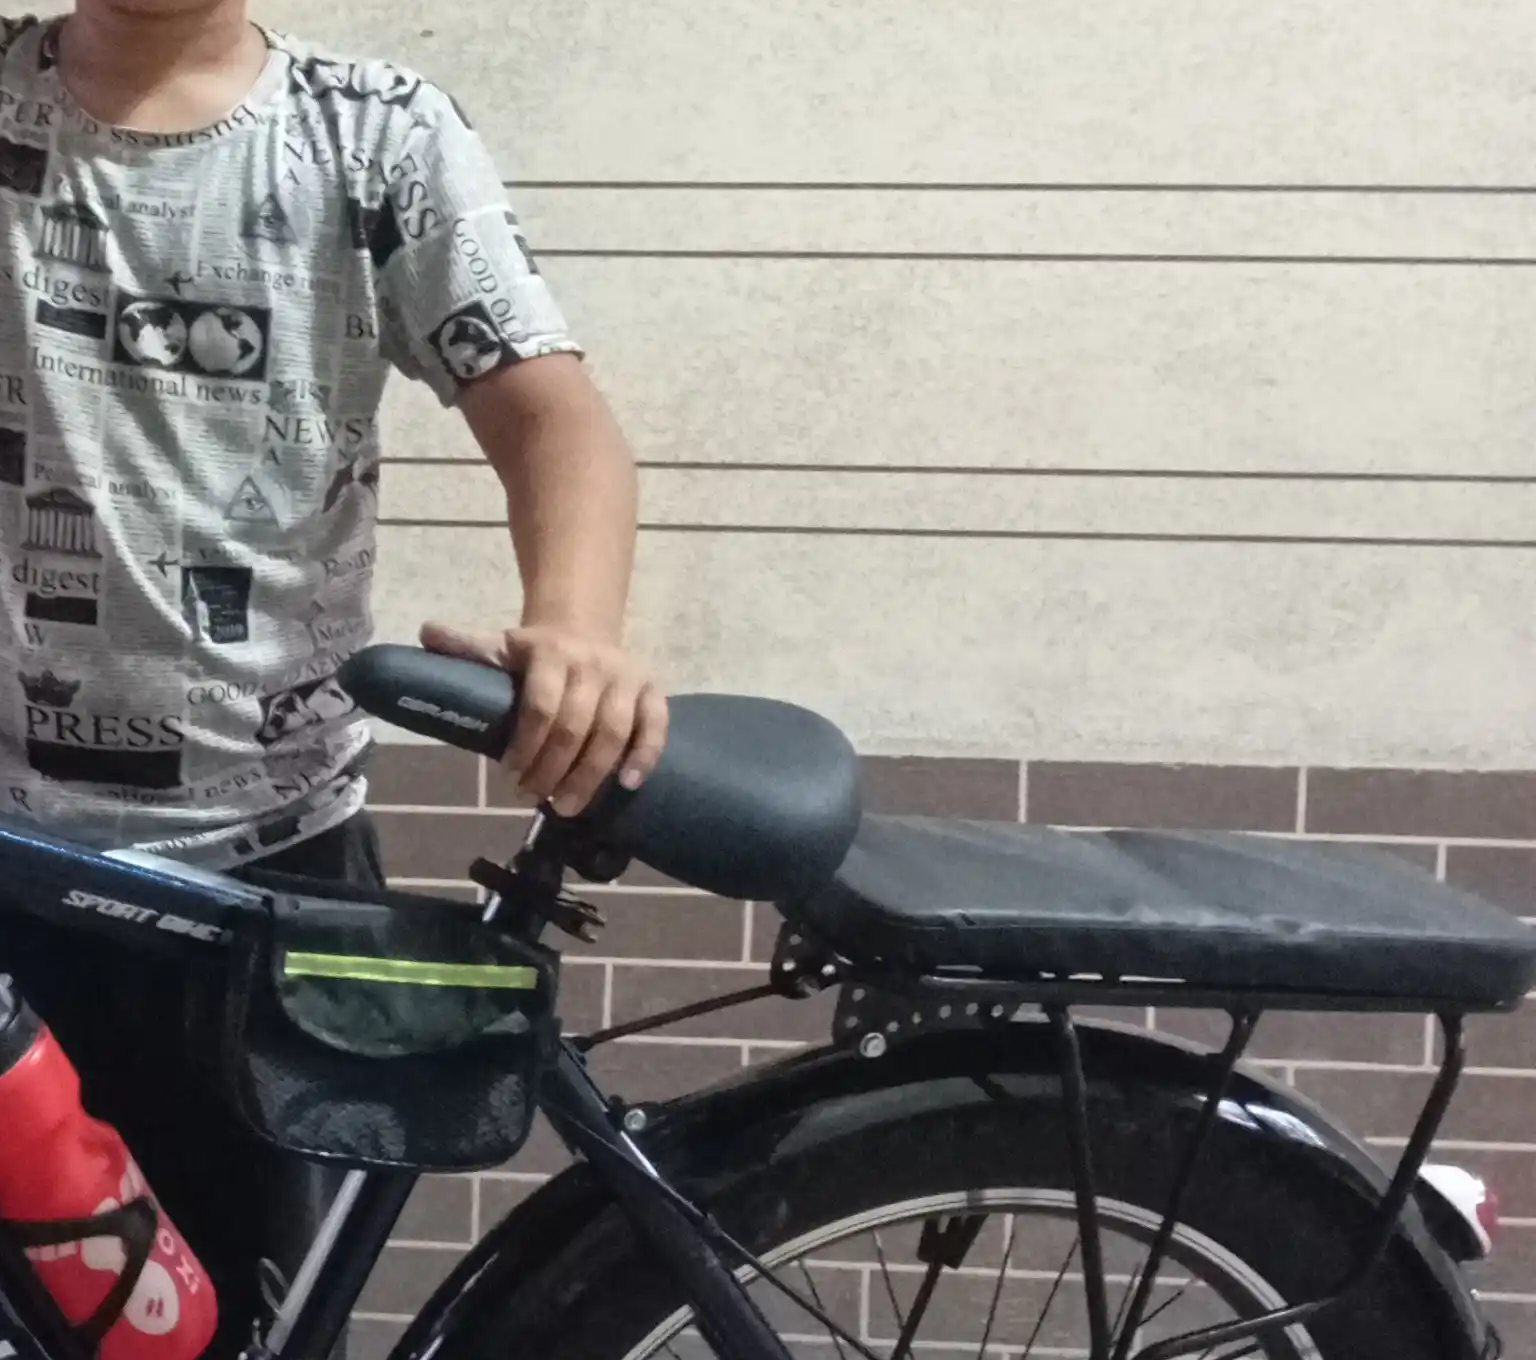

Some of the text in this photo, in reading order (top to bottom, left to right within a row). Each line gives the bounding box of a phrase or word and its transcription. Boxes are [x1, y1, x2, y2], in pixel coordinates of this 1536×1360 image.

[451, 217, 498, 294] GOOD
[32, 346, 262, 405] International news
[13, 558, 100, 596] digest
[23, 703, 186, 748] PRESS
[62, 888, 159, 927] SPORT
